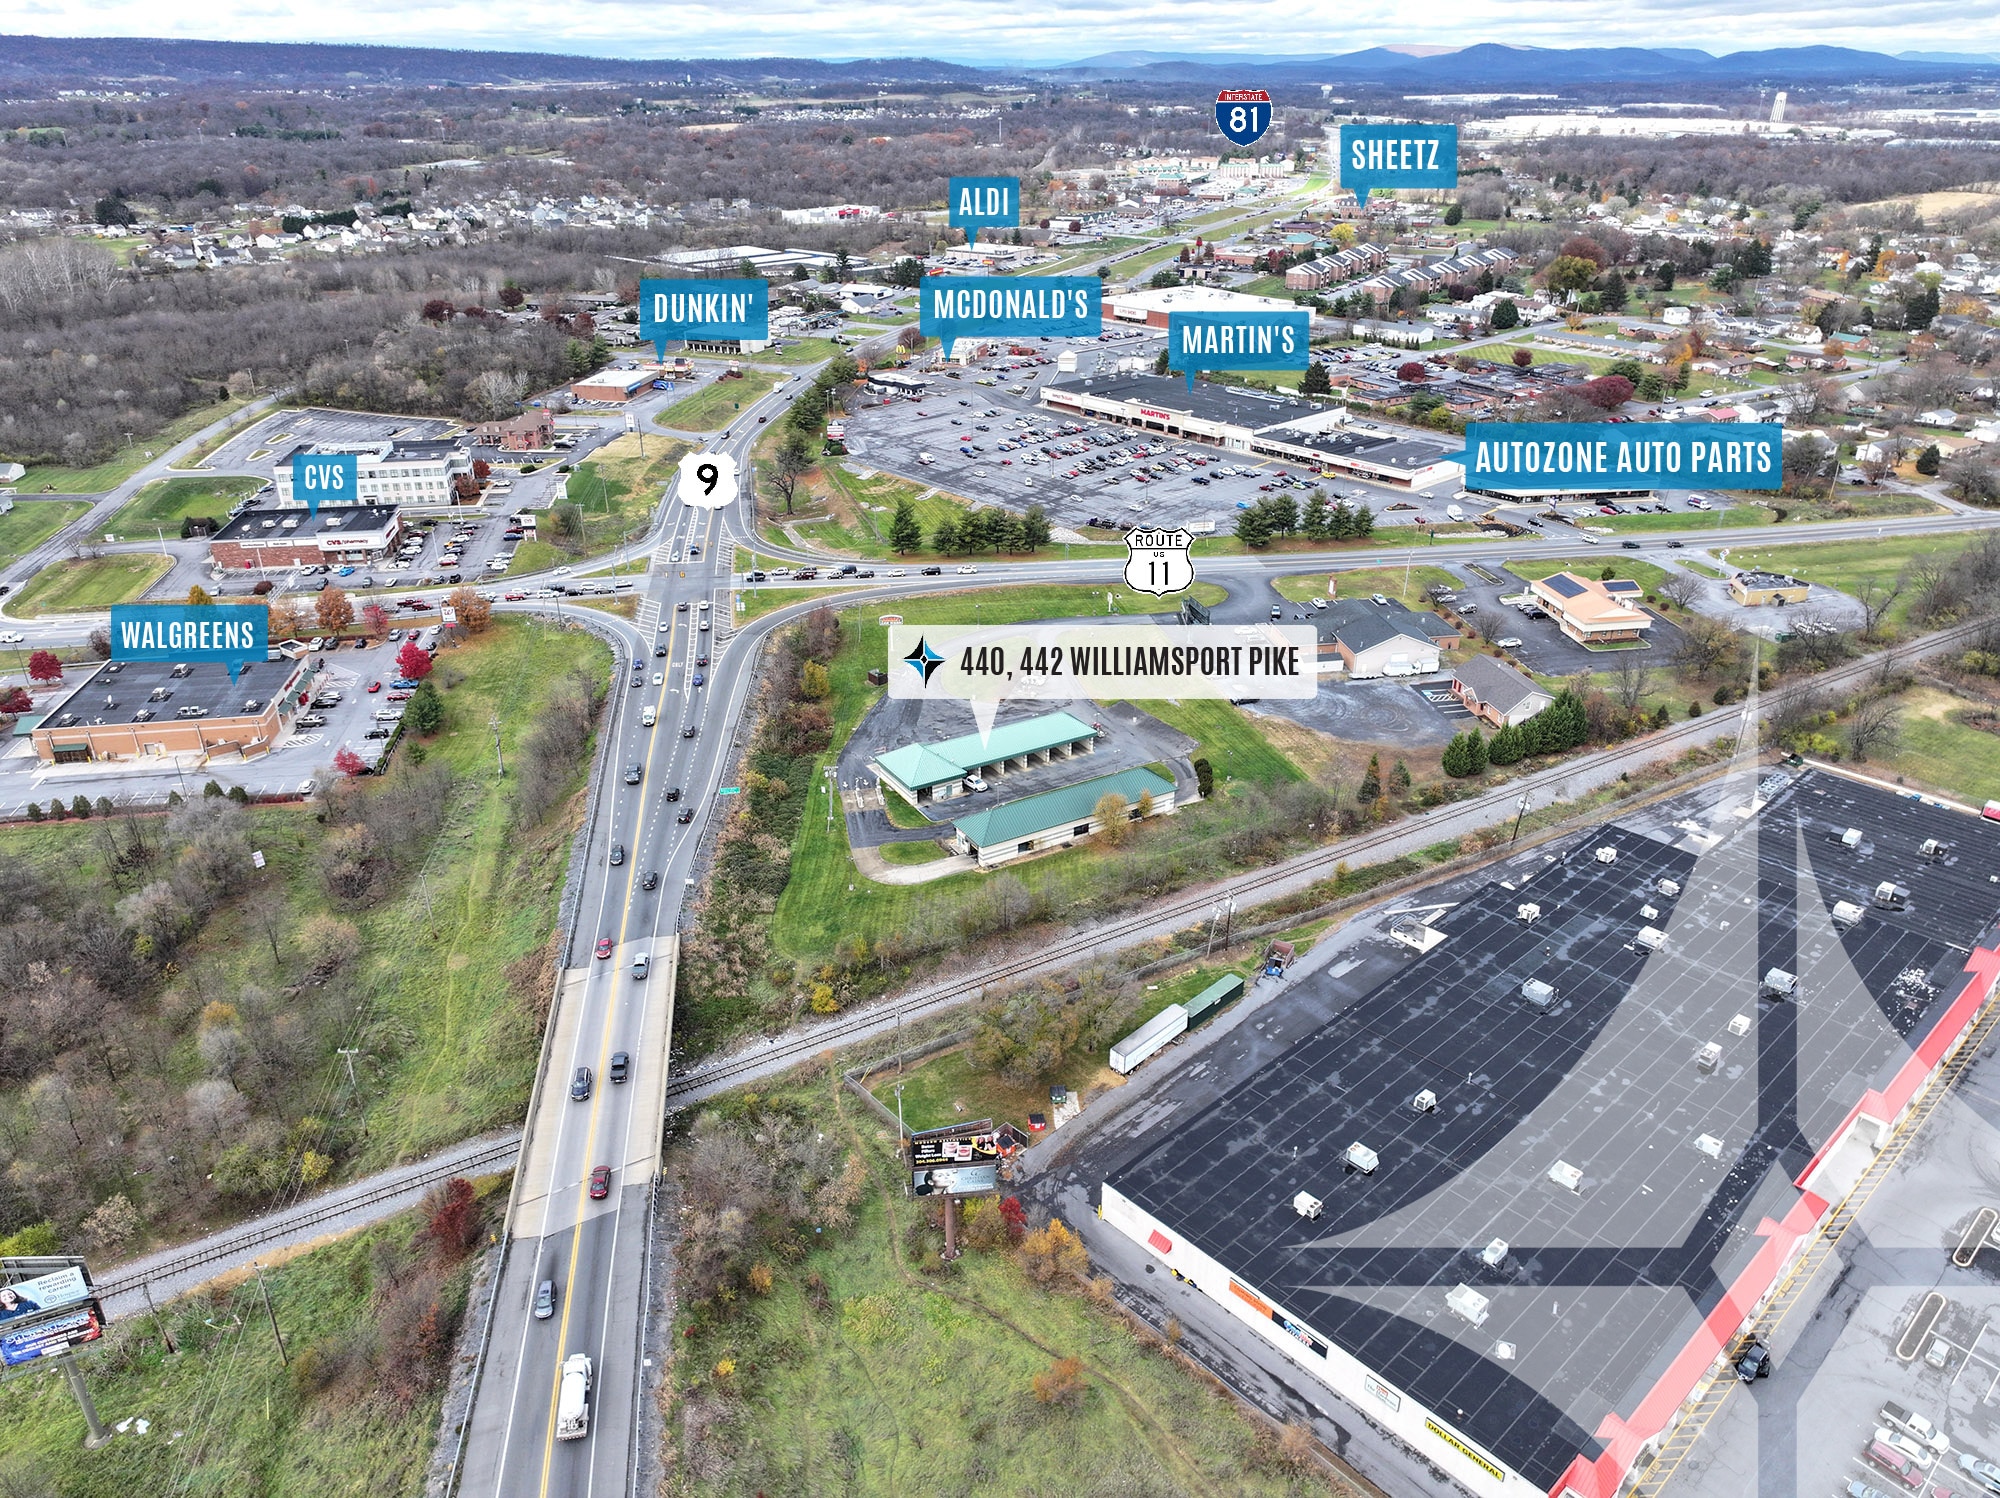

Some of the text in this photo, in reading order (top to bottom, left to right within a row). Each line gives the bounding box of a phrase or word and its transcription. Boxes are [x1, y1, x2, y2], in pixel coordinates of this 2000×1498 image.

[1140, 408, 1171, 421] MARTIN'S
[37, 1274, 68, 1286] Reclaim
[38, 1276, 77, 1291] rewarding
[48, 1283, 72, 1294] career
[1427, 1422, 1500, 1480] DOLLAR GENERAL
